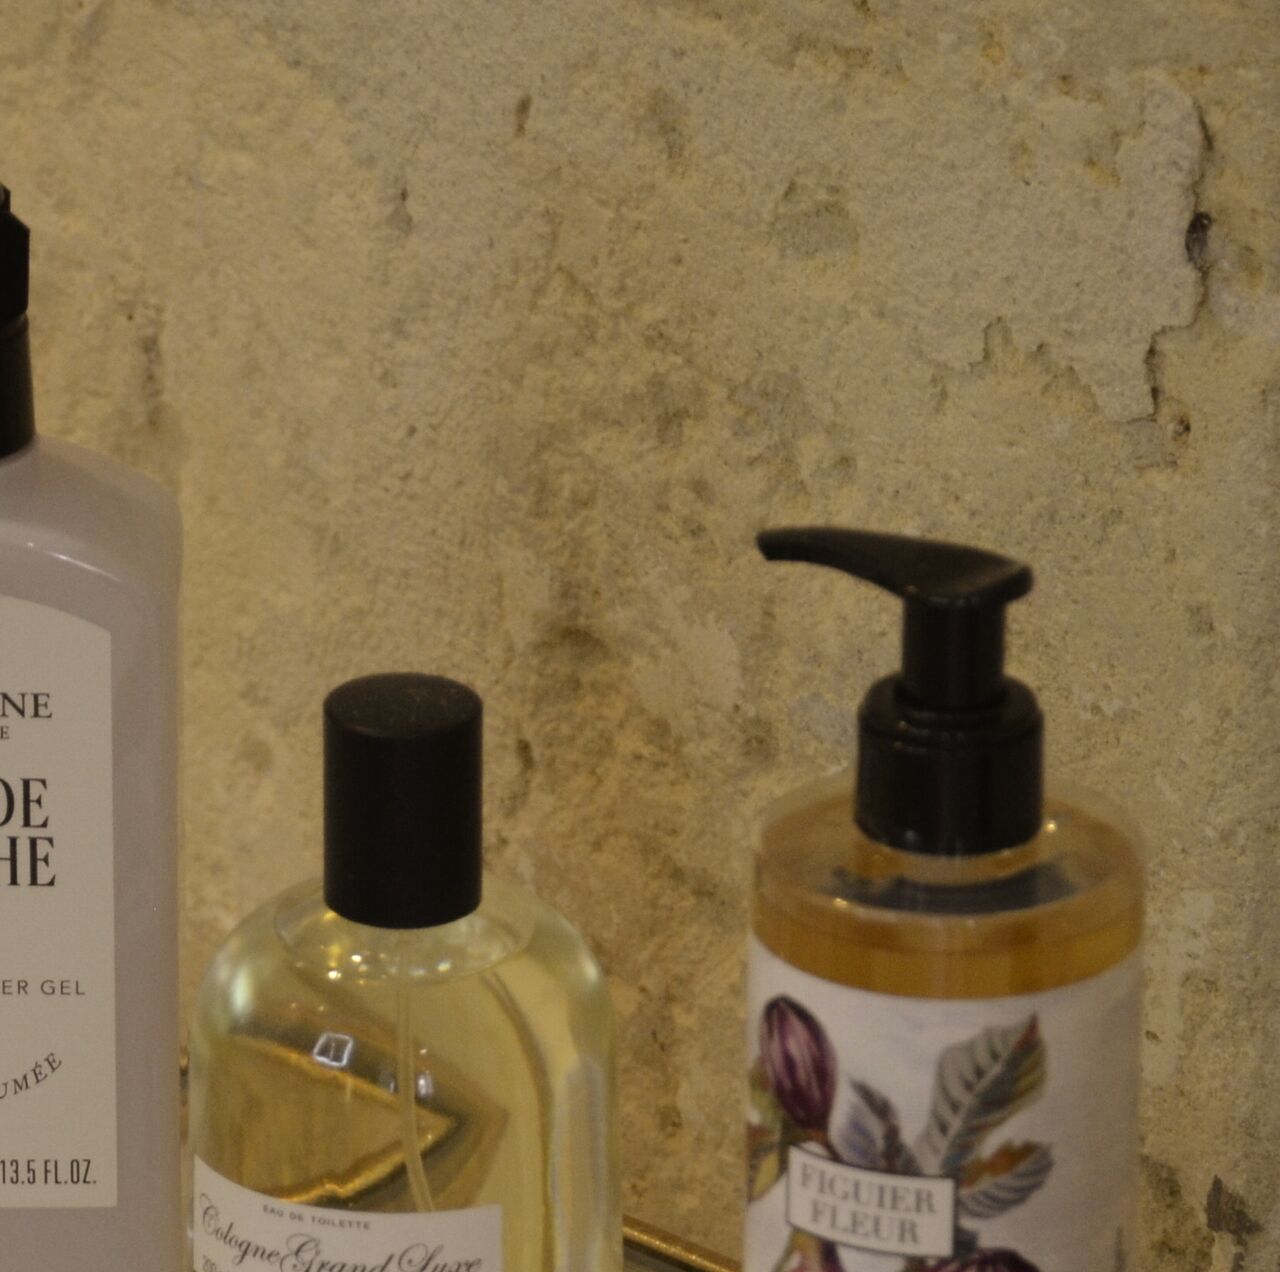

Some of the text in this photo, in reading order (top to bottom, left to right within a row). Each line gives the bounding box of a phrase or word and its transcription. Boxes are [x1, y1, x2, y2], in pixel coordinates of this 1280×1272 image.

[40, 979, 86, 996] GEL
[0, 1159, 36, 1185] 13.5
[801, 1162, 936, 1213] FIGUIER
[199, 1193, 280, 1265] Cologne
[262, 1204, 371, 1230] EAU DE TOILETTE
[812, 1199, 919, 1243] FLEUR
